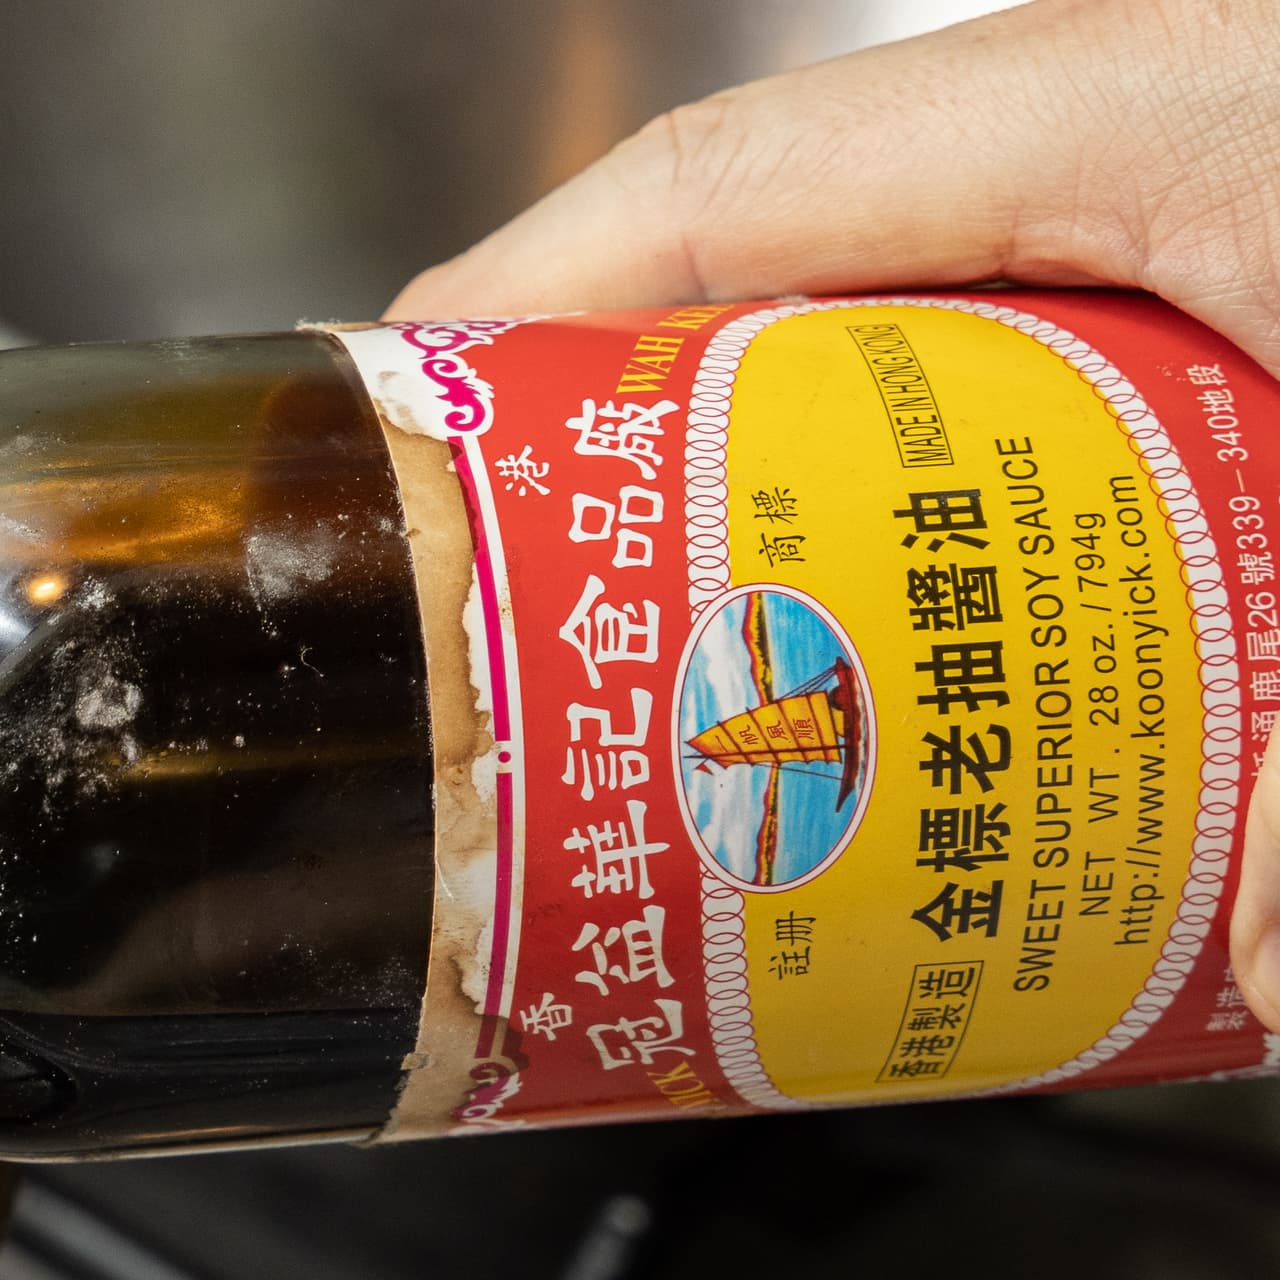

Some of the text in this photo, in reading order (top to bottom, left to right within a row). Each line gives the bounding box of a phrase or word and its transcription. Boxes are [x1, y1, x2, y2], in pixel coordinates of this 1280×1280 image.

[616, 335, 685, 393] WAH
[854, 325, 949, 462] MADE IN HONG KONG
[750, 486, 807, 568] 商標
[1071, 513, 1109, 593] 794g
[1092, 623, 1117, 674] oz.
[494, 446, 573, 1041] 香 港
[559, 397, 696, 1070] 冠益華記食品廠
[715, 718, 816, 754] 一帆風順
[893, 487, 1012, 942] 金標老抽醬油
[995, 437, 1073, 992] SWEET SUPERIOR SOY SAUCE
[1088, 685, 1120, 726] 28
[1109, 475, 1169, 945] http://www.koonyick.com
[1079, 851, 1116, 916] NET
[888, 966, 975, 1077] 香港製造
